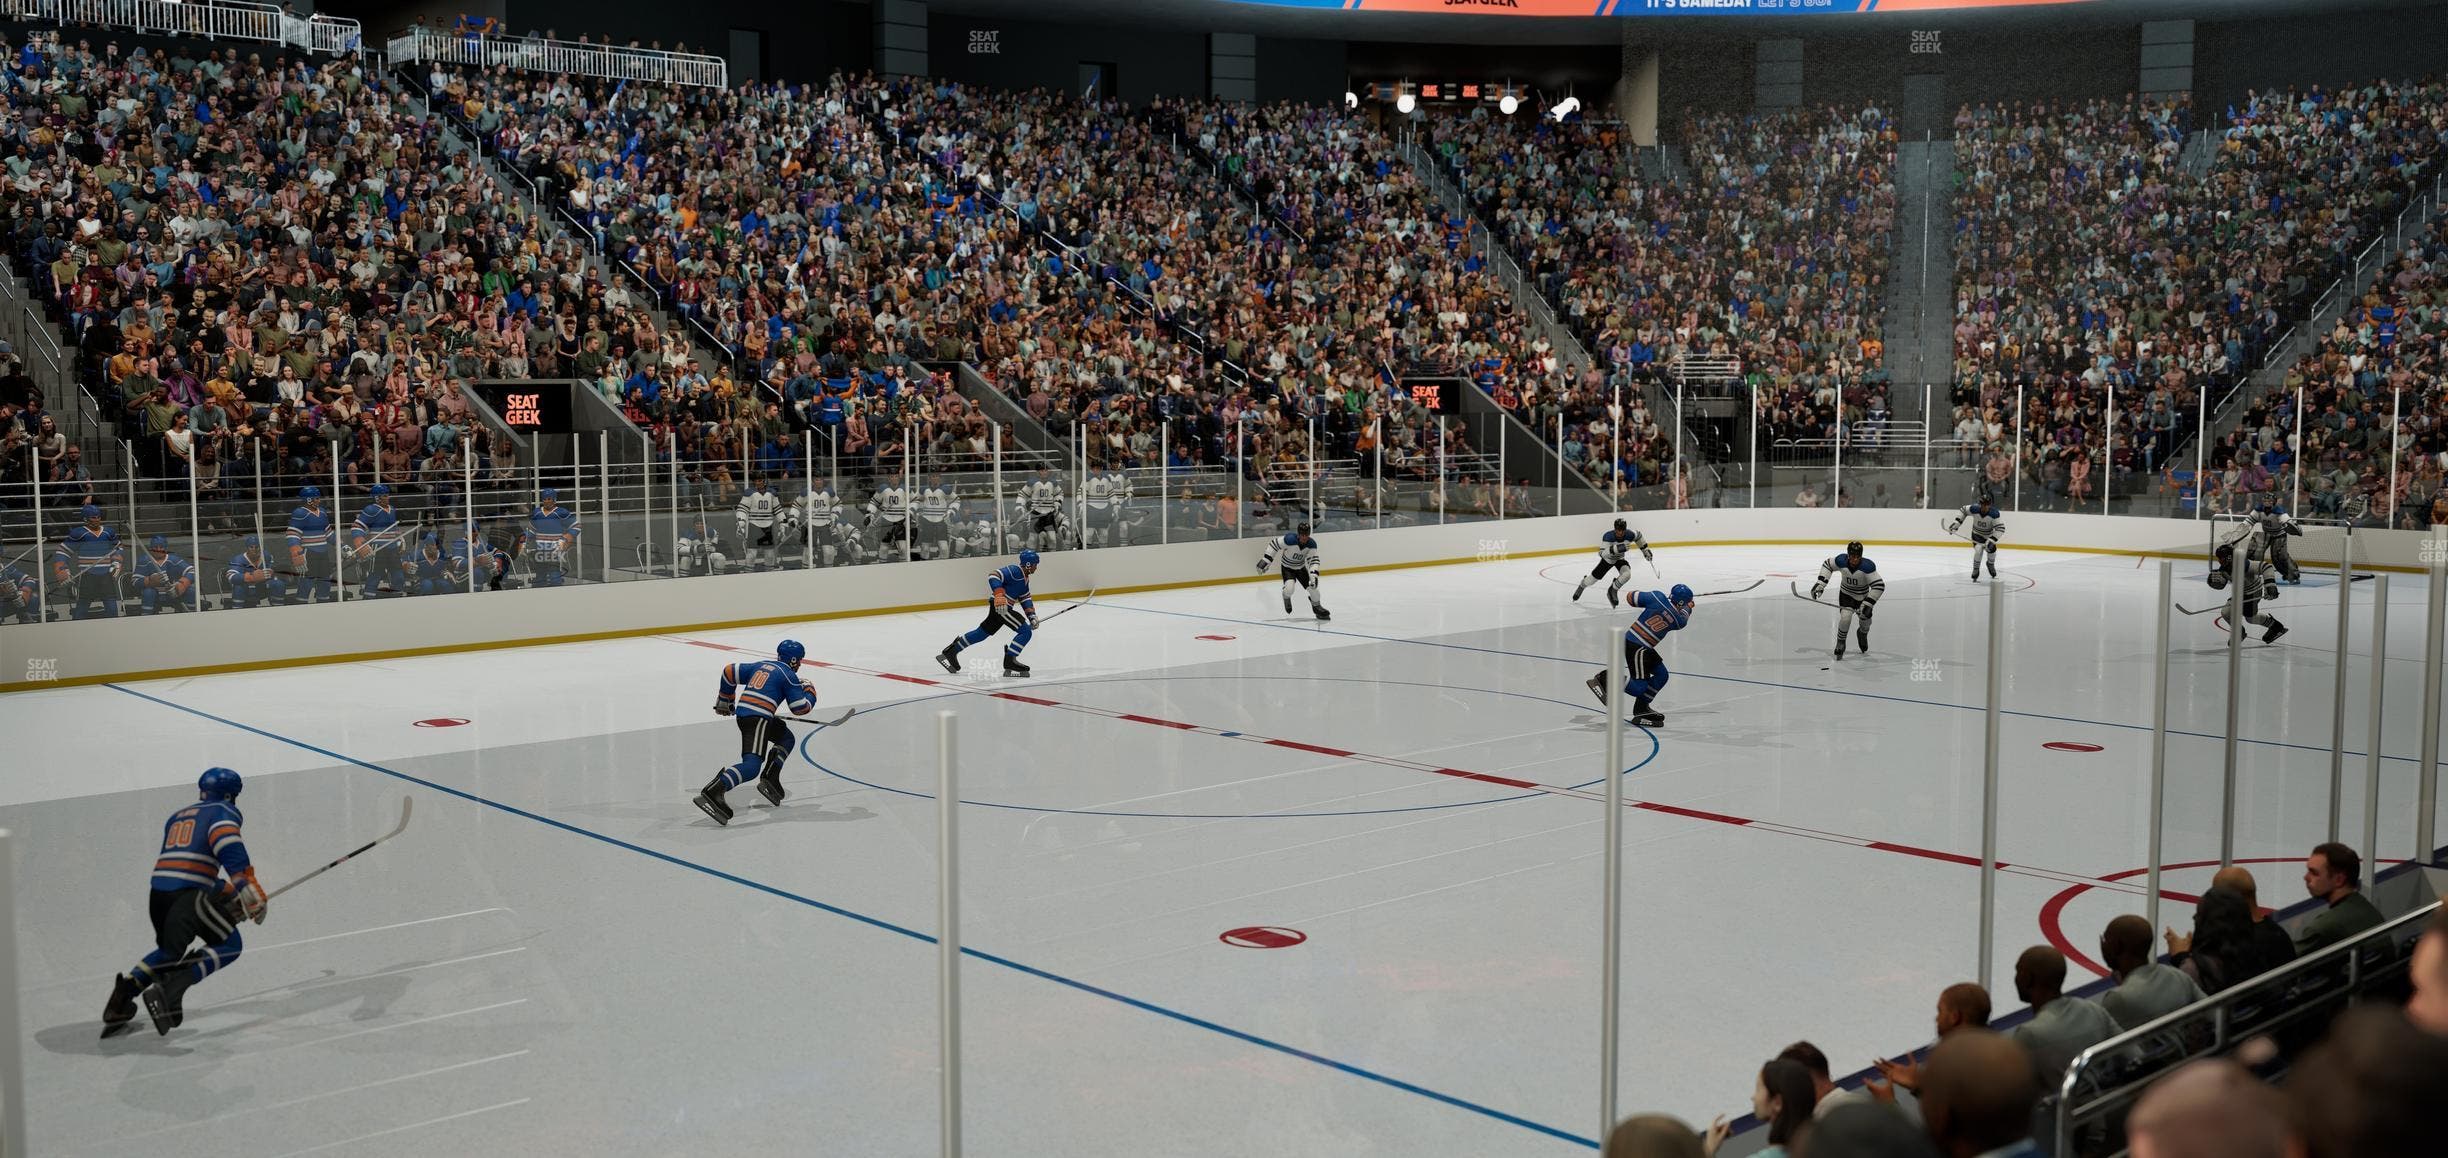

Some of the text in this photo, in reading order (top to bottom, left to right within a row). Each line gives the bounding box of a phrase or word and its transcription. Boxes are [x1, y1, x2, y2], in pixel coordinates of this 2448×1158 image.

[1412, 385, 1440, 397] SEAT
[507, 394, 539, 409] SEAT
[505, 409, 541, 425] GEEK
[758, 500, 768, 510] 00
[1846, 577, 1858, 585] 00
[1645, 615, 1668, 632] 00
[749, 671, 769, 689] 00
[165, 819, 196, 848] 00
